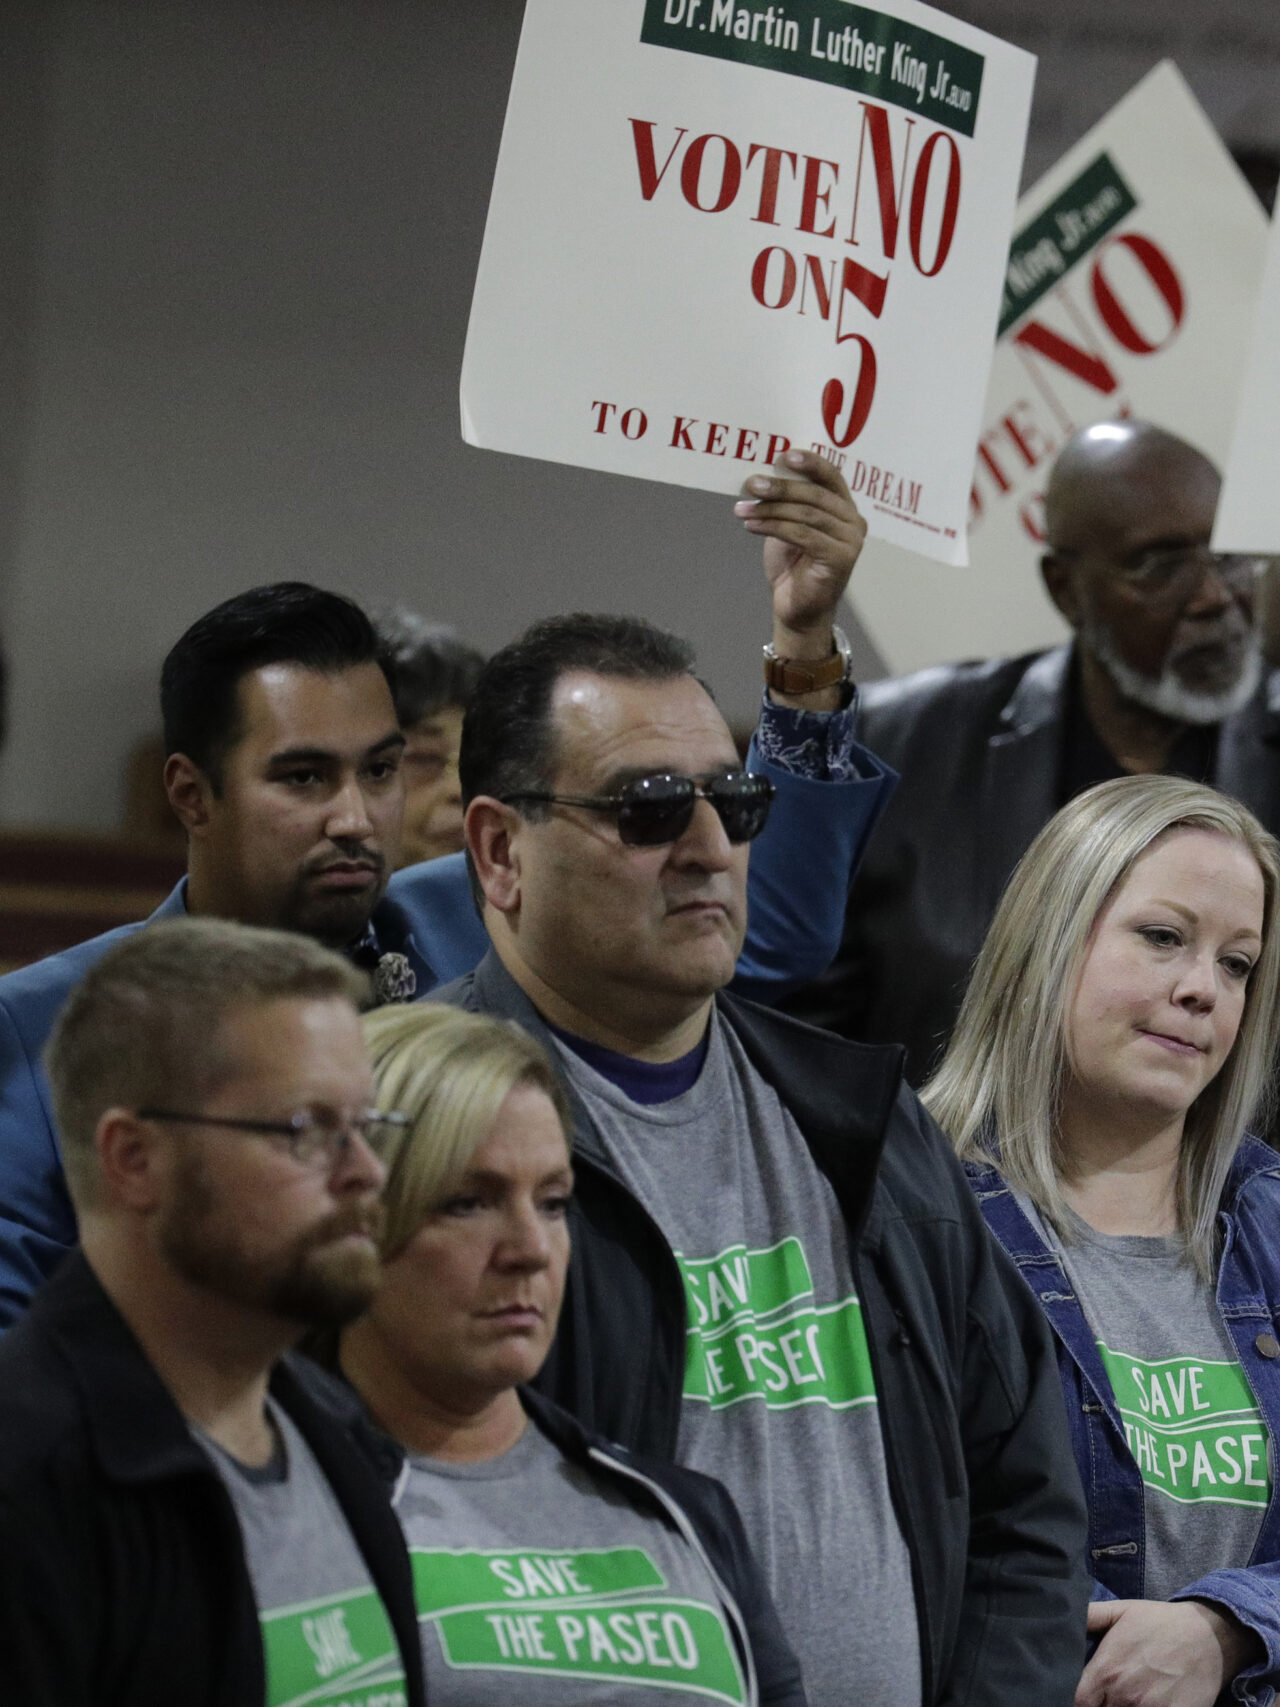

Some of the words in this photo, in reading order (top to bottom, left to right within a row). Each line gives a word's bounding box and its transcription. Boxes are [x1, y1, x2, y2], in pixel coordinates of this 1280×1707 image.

[811, 17, 886, 75] Luther
[891, 41, 927, 104] King
[627, 117, 840, 239] VOTE
[844, 100, 962, 278] NO
[750, 245, 837, 321] ON
[821, 256, 890, 448] 5
[1013, 231, 1187, 441] NO
[591, 400, 649, 441] TO
[668, 415, 791, 466] KEEP
[851, 460, 923, 514] DREAM
[687, 1255, 750, 1326] SAV
[1131, 1366, 1211, 1419] SAVE
[1122, 1421, 1166, 1479] THE
[1166, 1433, 1275, 1488] PASE
[489, 1556, 593, 1599] SAVE
[485, 1613, 557, 1661] THE
[554, 1610, 699, 1671] PASEO
